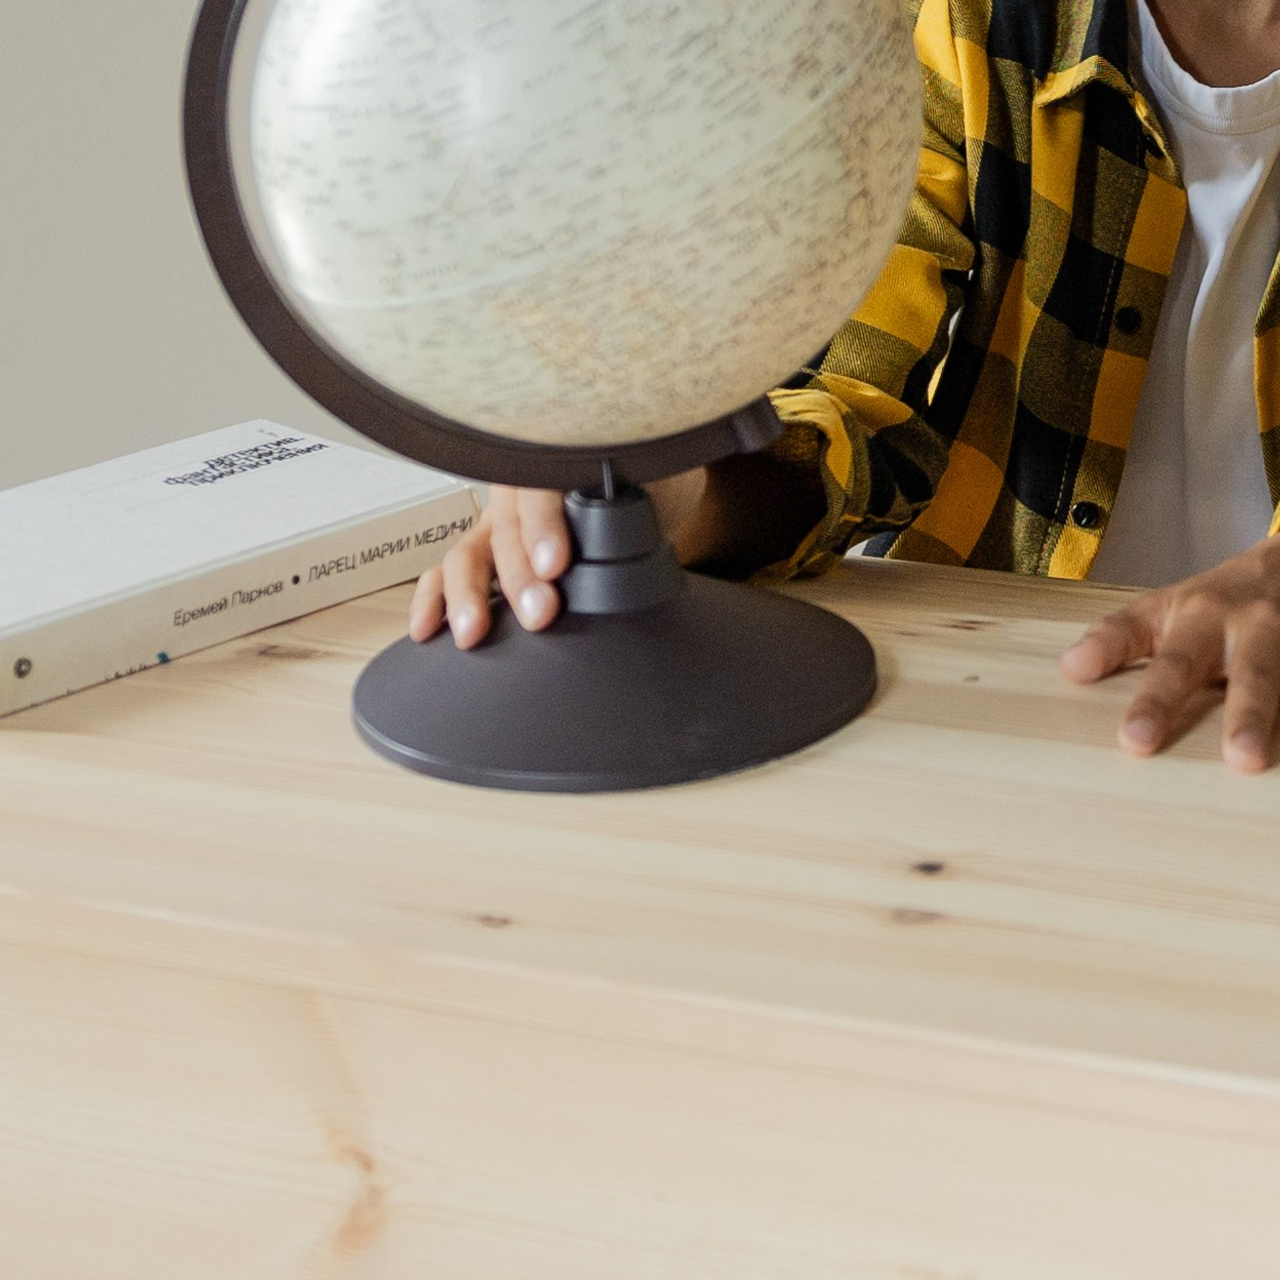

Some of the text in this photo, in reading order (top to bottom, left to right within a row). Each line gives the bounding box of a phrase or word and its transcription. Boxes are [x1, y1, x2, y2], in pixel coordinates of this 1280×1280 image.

[173, 595, 228, 627] Еремей
[231, 581, 284, 608] Парнов
[359, 536, 411, 566] МАРИИ
[414, 516, 473, 548] МЕДИЧИ
